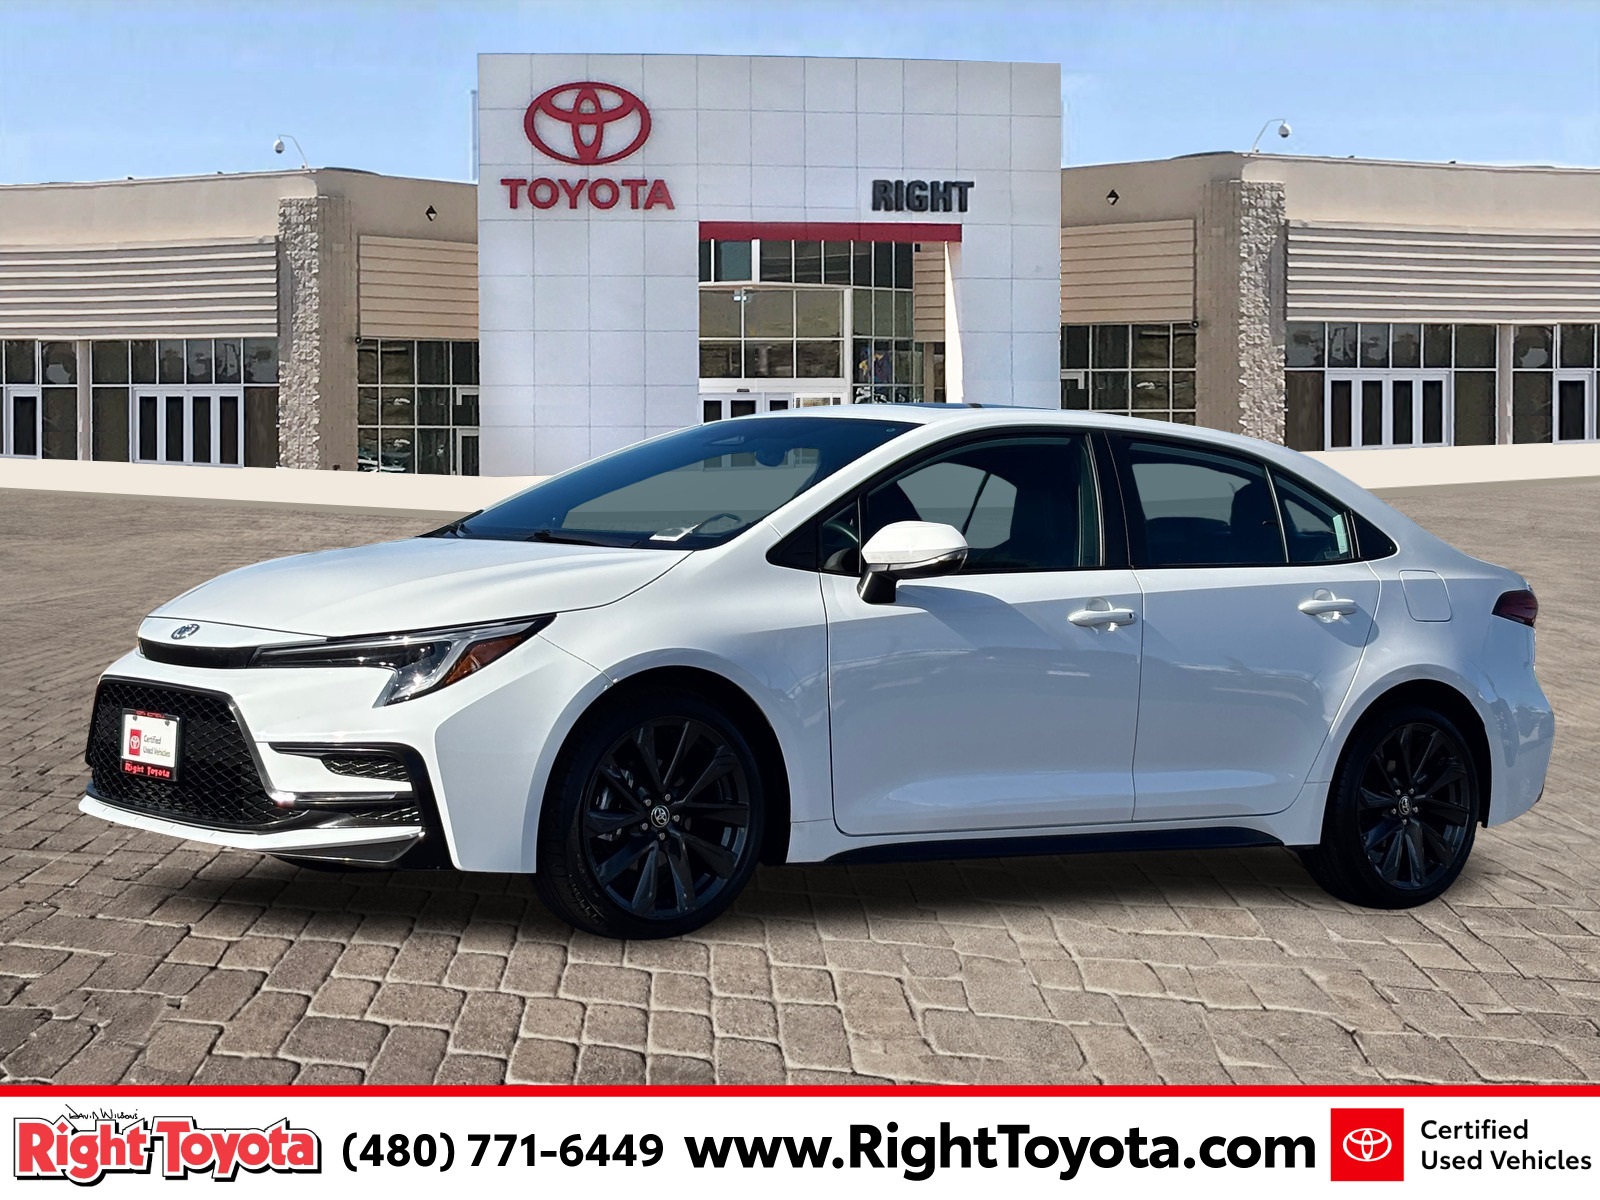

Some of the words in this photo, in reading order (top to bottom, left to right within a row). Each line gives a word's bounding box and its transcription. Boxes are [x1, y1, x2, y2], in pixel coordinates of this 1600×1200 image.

[500, 178, 675, 210] TOYOTA
[871, 179, 975, 213] RIGHT
[143, 734, 162, 745] Certified
[143, 747, 154, 755] Used
[154, 747, 171, 757] Vehicles
[125, 762, 144, 774] Right
[147, 767, 171, 778] Toyota
